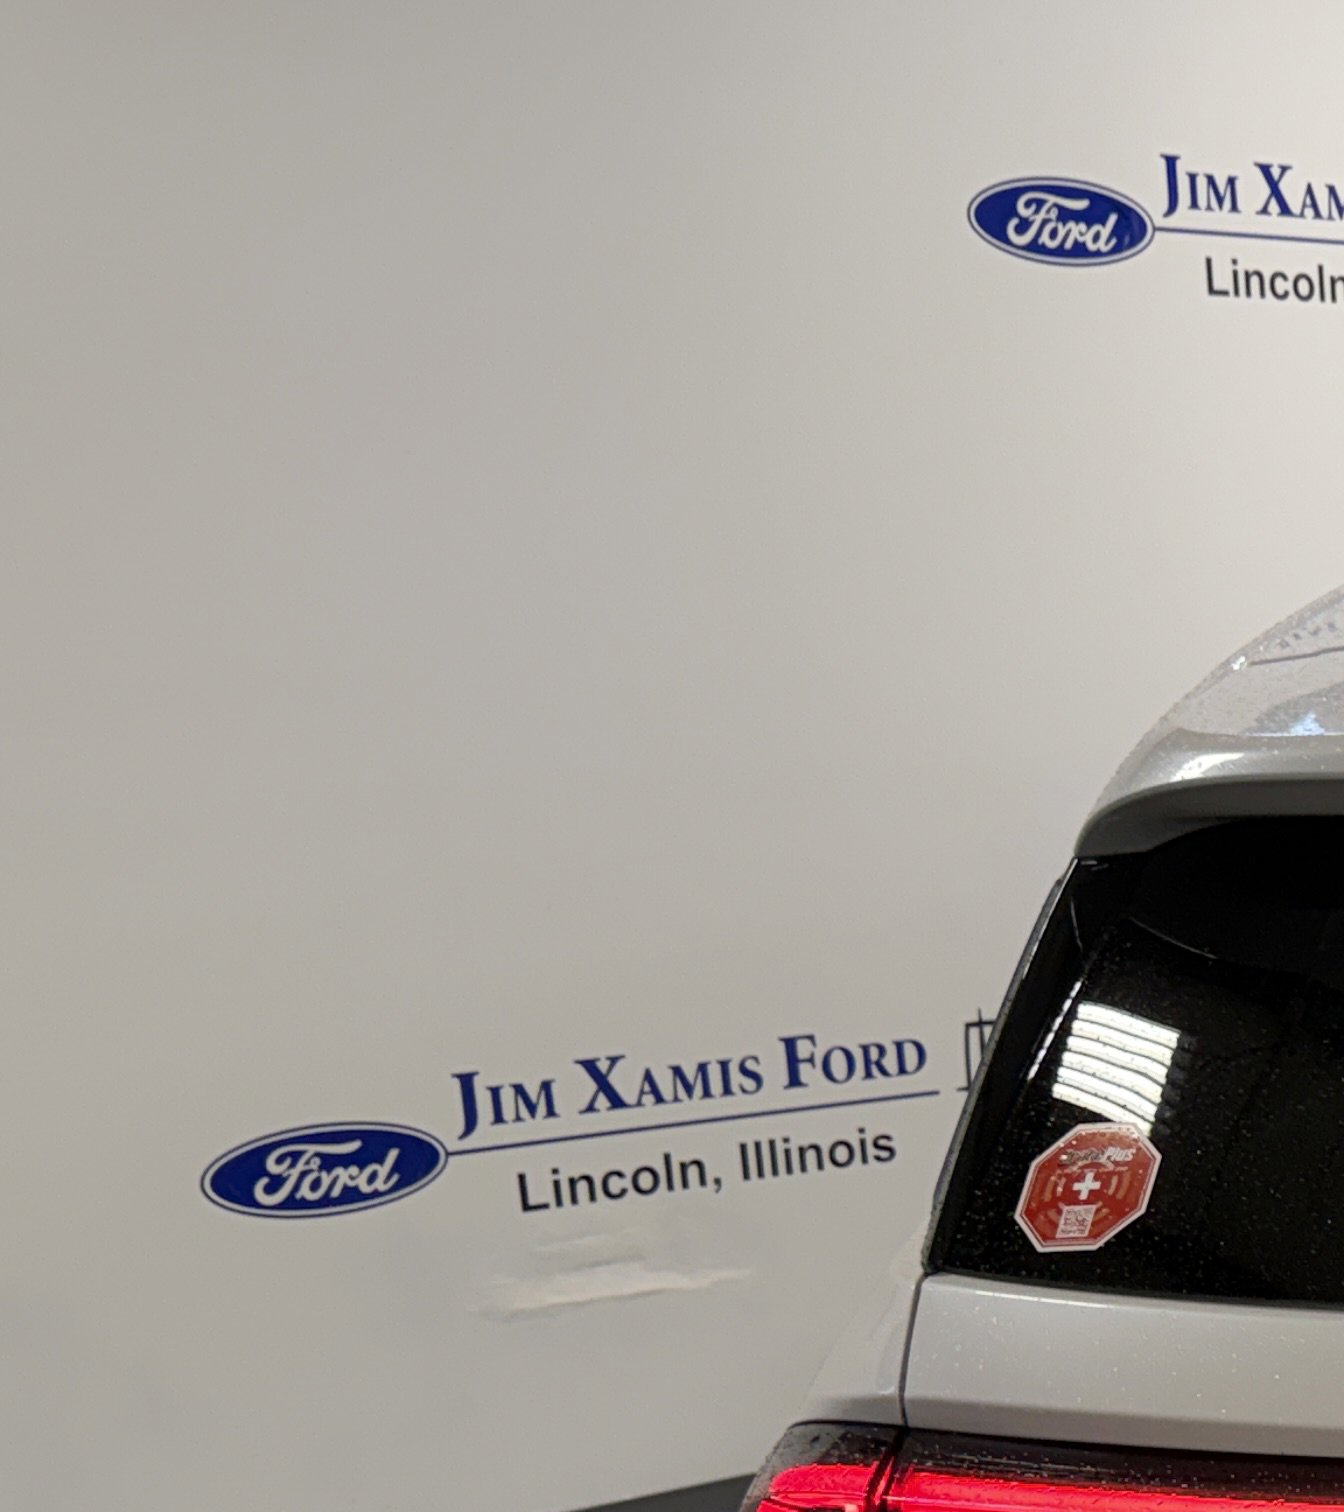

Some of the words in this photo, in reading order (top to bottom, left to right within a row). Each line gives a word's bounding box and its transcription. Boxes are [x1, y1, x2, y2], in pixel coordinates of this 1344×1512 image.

[1160, 154, 1241, 218] JIM
[1006, 191, 1119, 254] Ford
[451, 1071, 556, 1141] JIM
[574, 1054, 765, 1114] XAMIS
[777, 1034, 928, 1091] FORD
[253, 1139, 400, 1205] Ford
[517, 1151, 723, 1214] Lincoln,
[738, 1126, 898, 1183] Illinois
